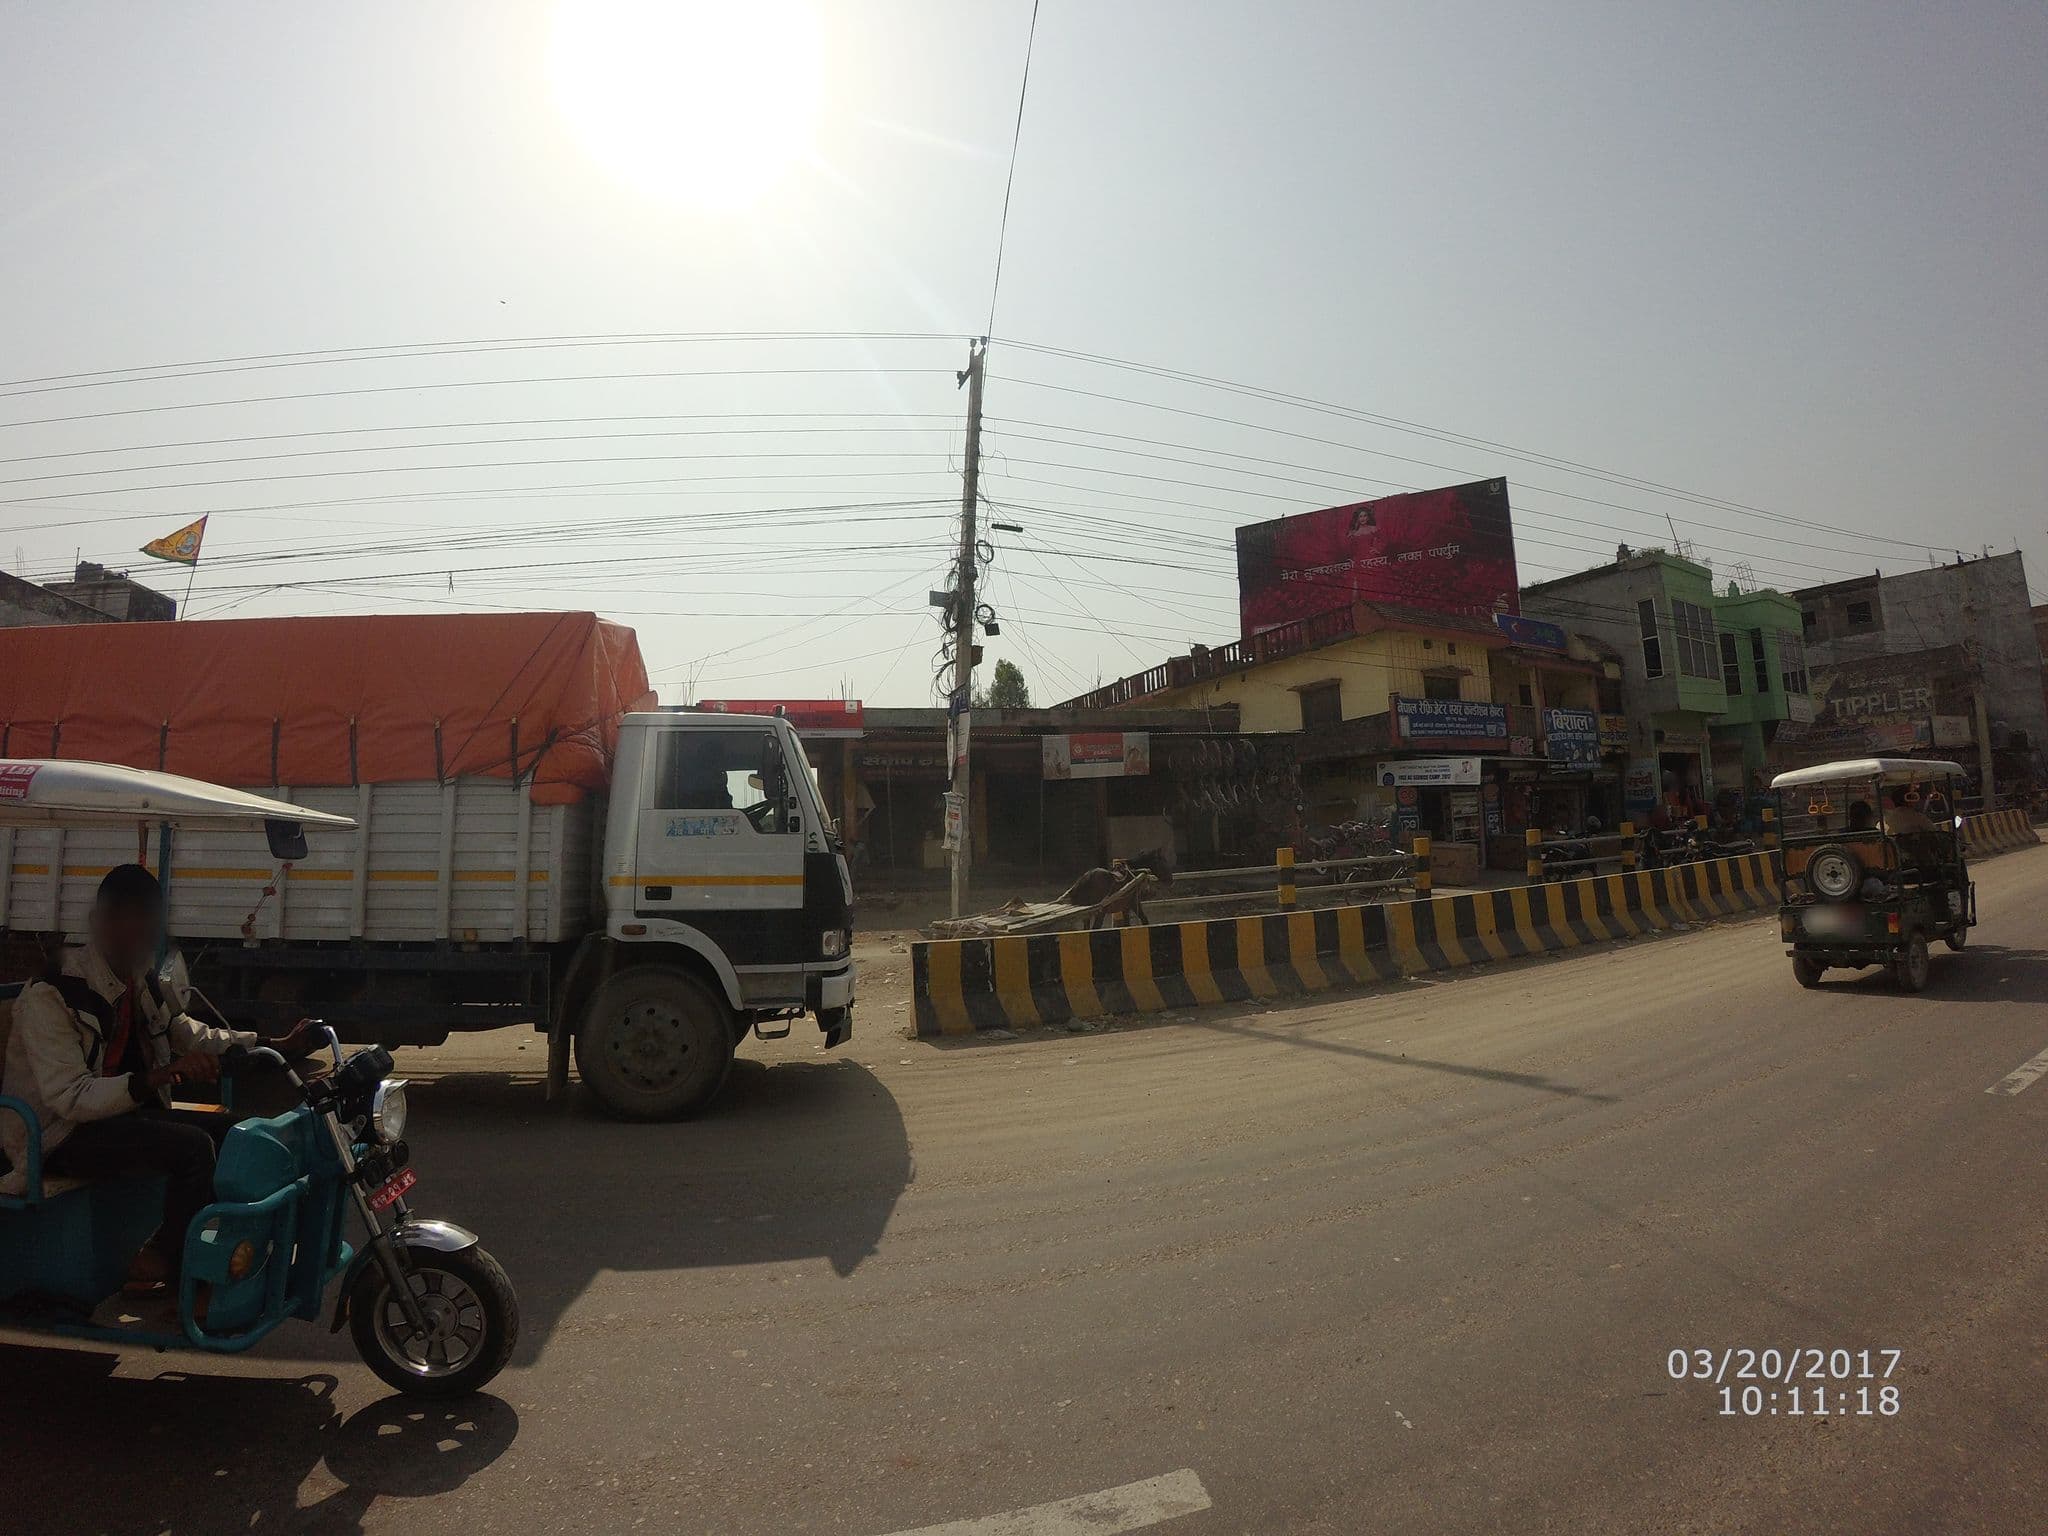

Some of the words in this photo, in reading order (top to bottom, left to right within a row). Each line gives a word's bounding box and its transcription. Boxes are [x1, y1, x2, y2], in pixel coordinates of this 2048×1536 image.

[1397, 699, 1417, 714] नेपाल
[1830, 688, 1928, 717] TIPPLER
[1551, 709, 1588, 731] बिशाल
[7, 765, 35, 775] Lab
